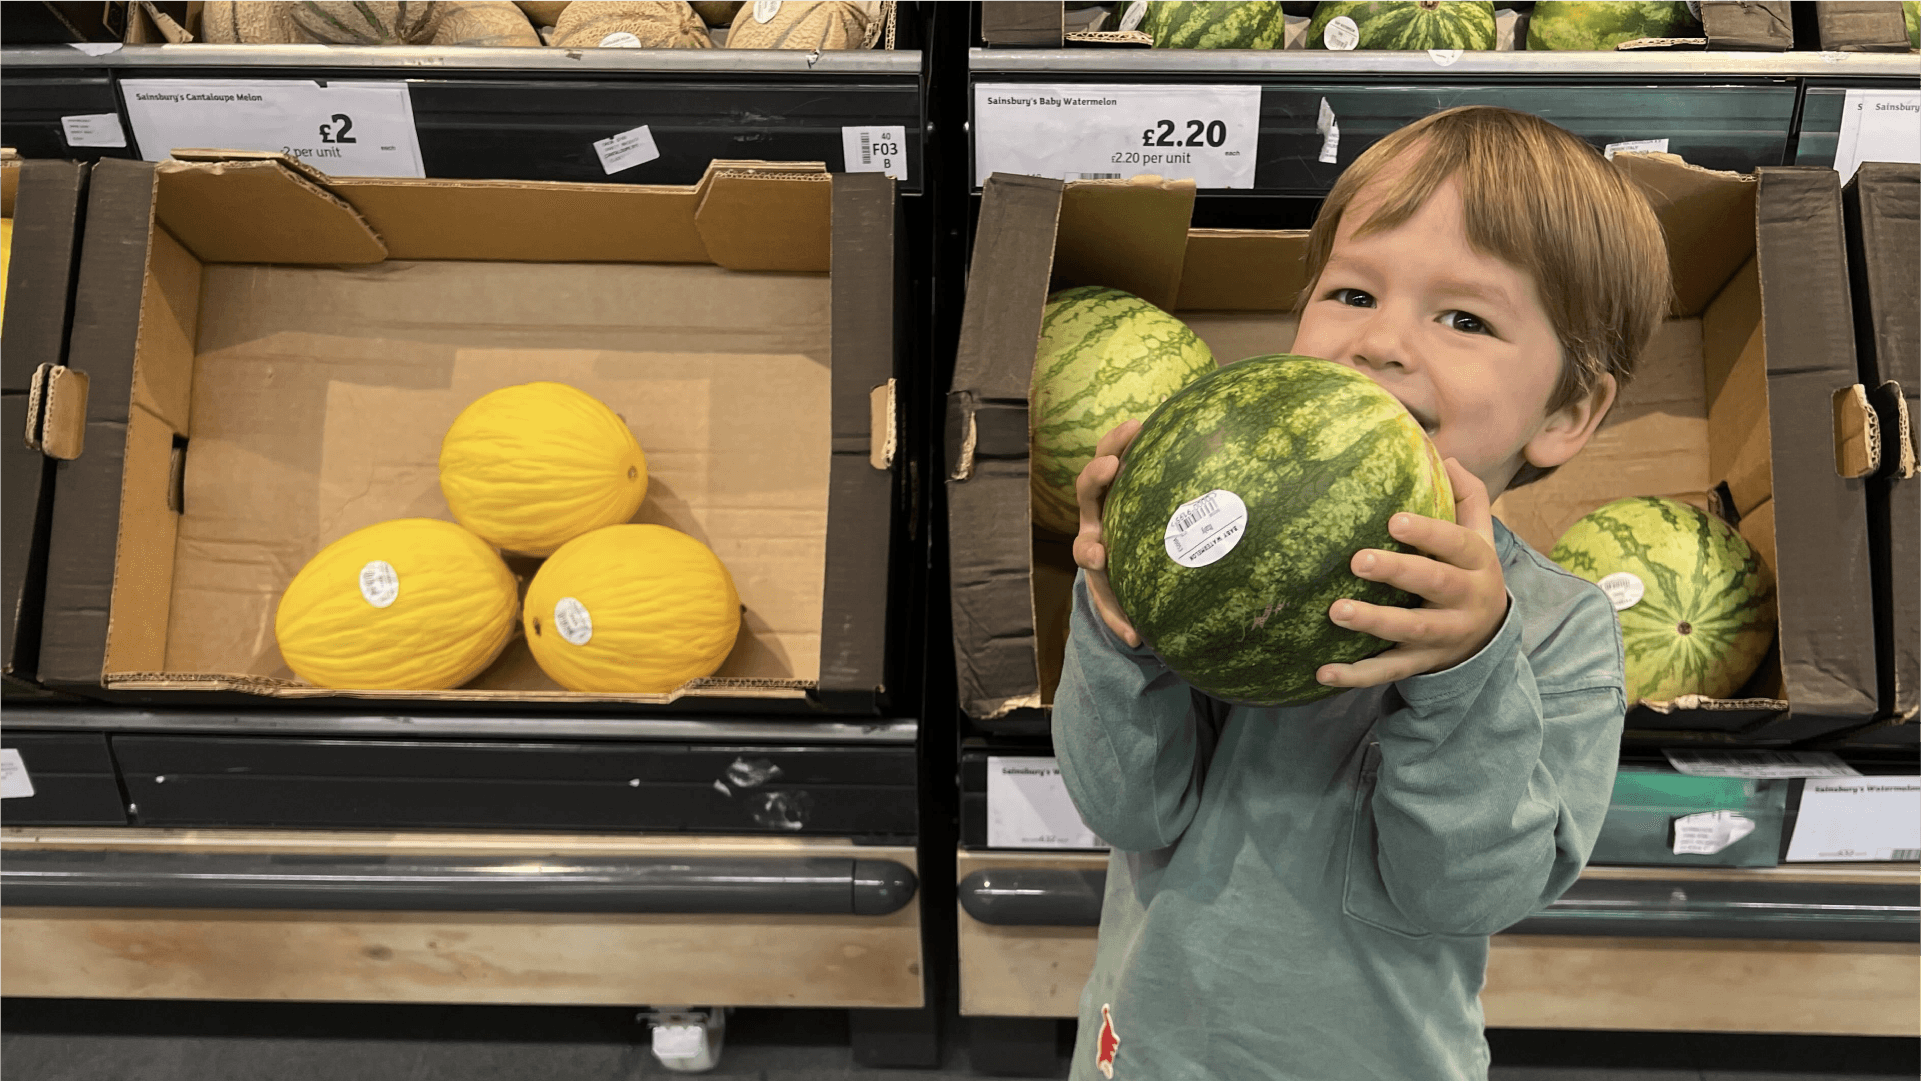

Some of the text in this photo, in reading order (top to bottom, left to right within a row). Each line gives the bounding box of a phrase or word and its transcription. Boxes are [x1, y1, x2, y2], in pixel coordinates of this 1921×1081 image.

[136, 93, 262, 104] Sainsbury's Cantaloupe Melon
[988, 97, 1118, 106] Sainsbury's Baby Watermelon
[319, 114, 356, 144] £2
[1142, 119, 1226, 148] £2.20
[294, 148, 314, 158] per
[316, 147, 342, 158] unit
[872, 142, 898, 156] F03
[884, 158, 891, 168] B
[1111, 152, 1192, 166] £2.20 per unit
[1189, 525, 1239, 561] BABY WATERMELON
[1002, 768, 1050, 776] Sainsbury's
[1815, 786, 1864, 794] Sainsbury's
